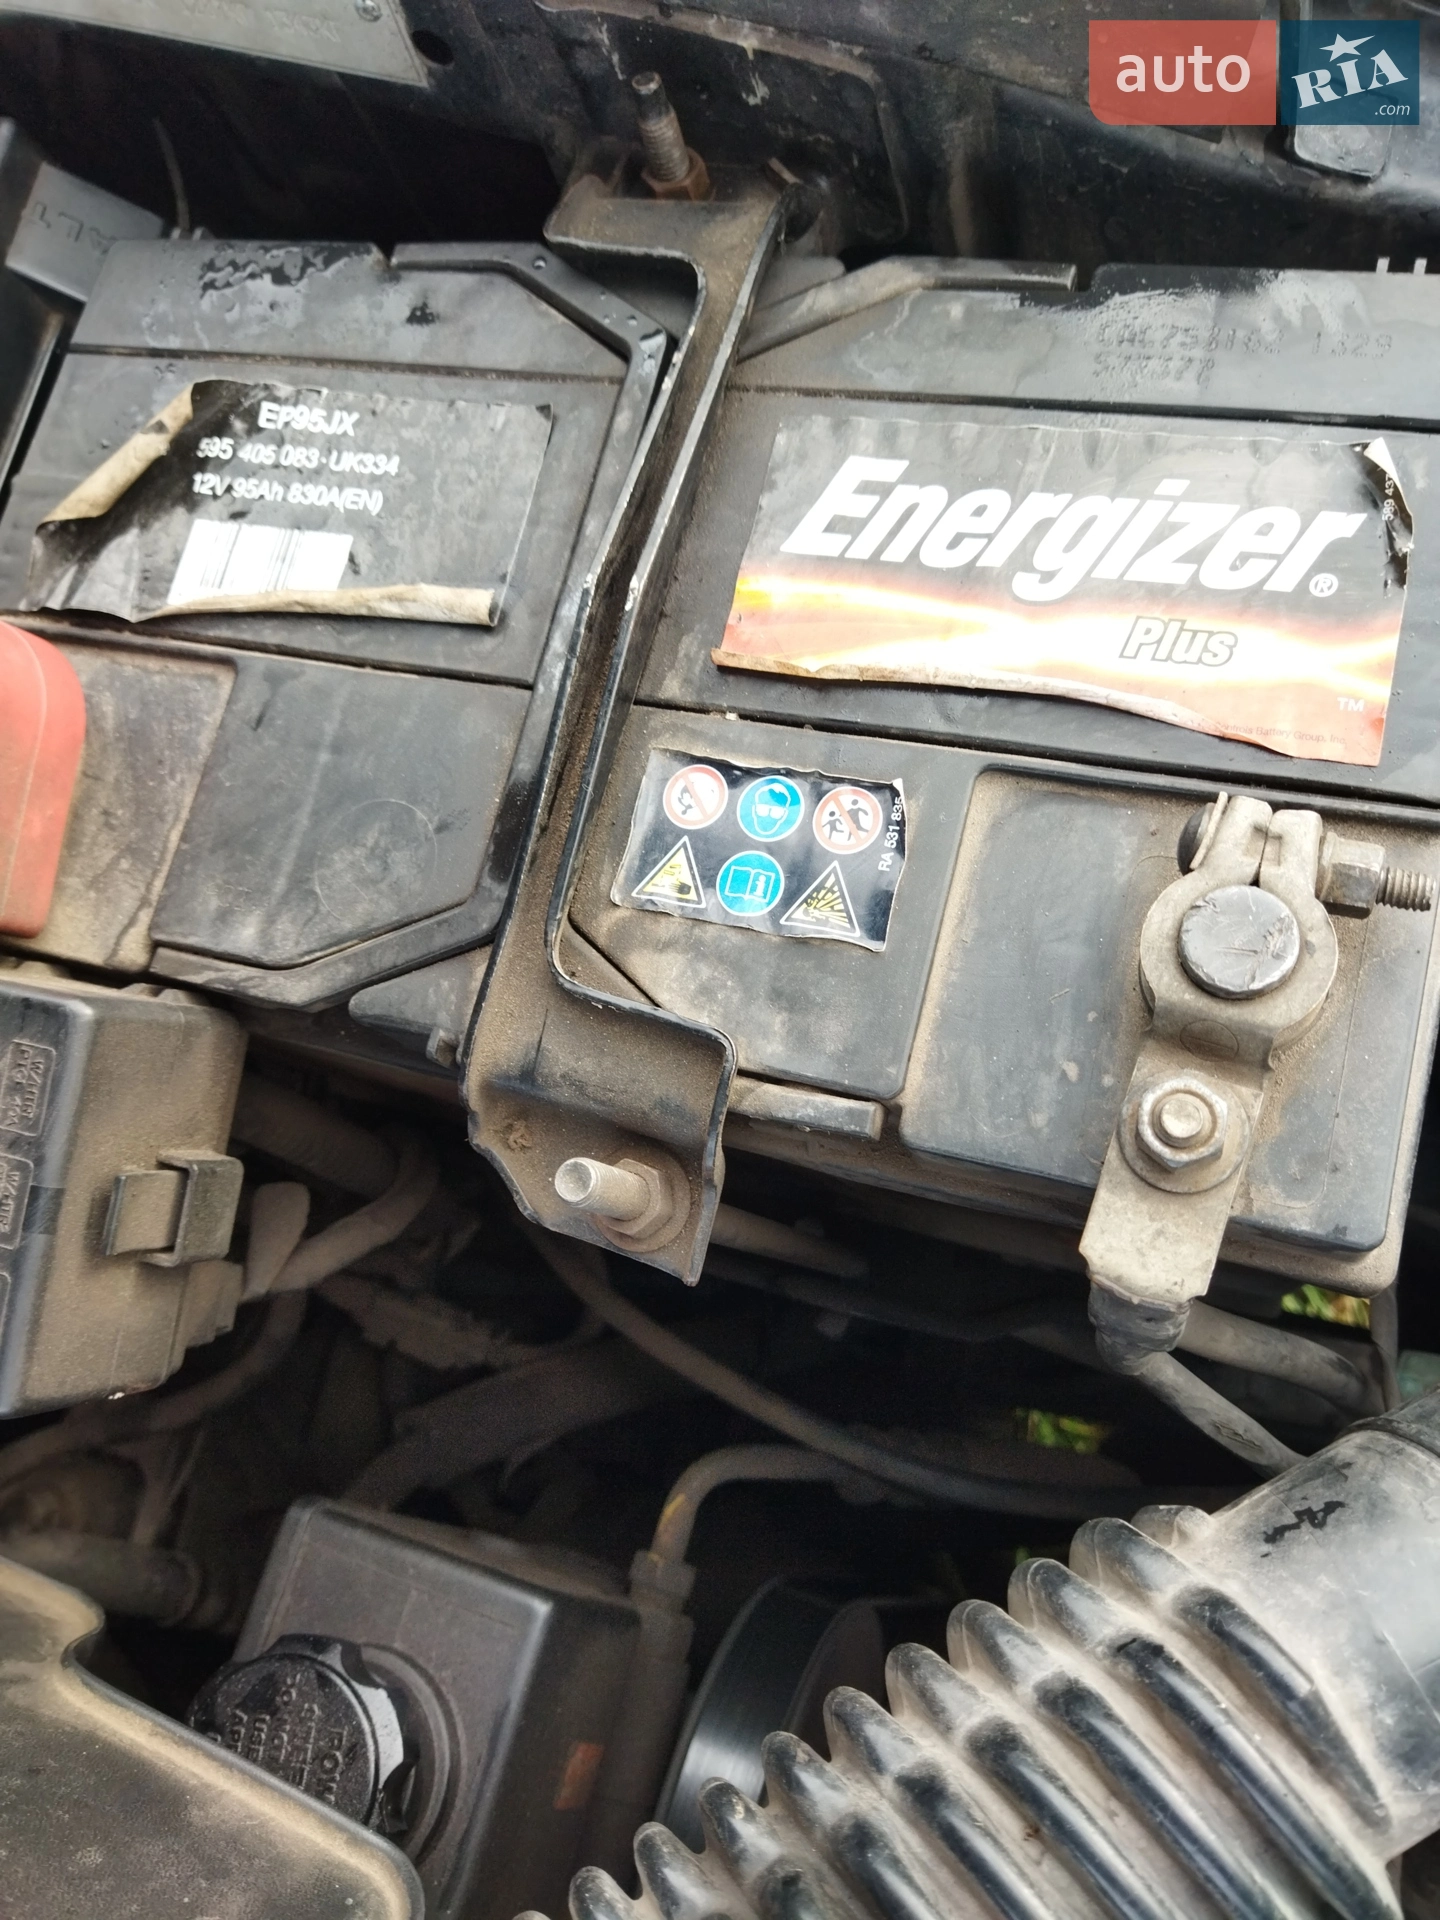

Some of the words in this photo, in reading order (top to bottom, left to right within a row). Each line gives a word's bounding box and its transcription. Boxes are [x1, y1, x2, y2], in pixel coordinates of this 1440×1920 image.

[258, 400, 361, 437] EP95JX
[196, 436, 235, 460] 595
[237, 442, 277, 466] 405
[192, 472, 232, 496] 12V
[231, 476, 285, 502] 95Ah
[1119, 614, 1239, 667] Plus
[891, 796, 903, 821] 835
[884, 825, 900, 849] 531
[878, 852, 894, 871] RA
